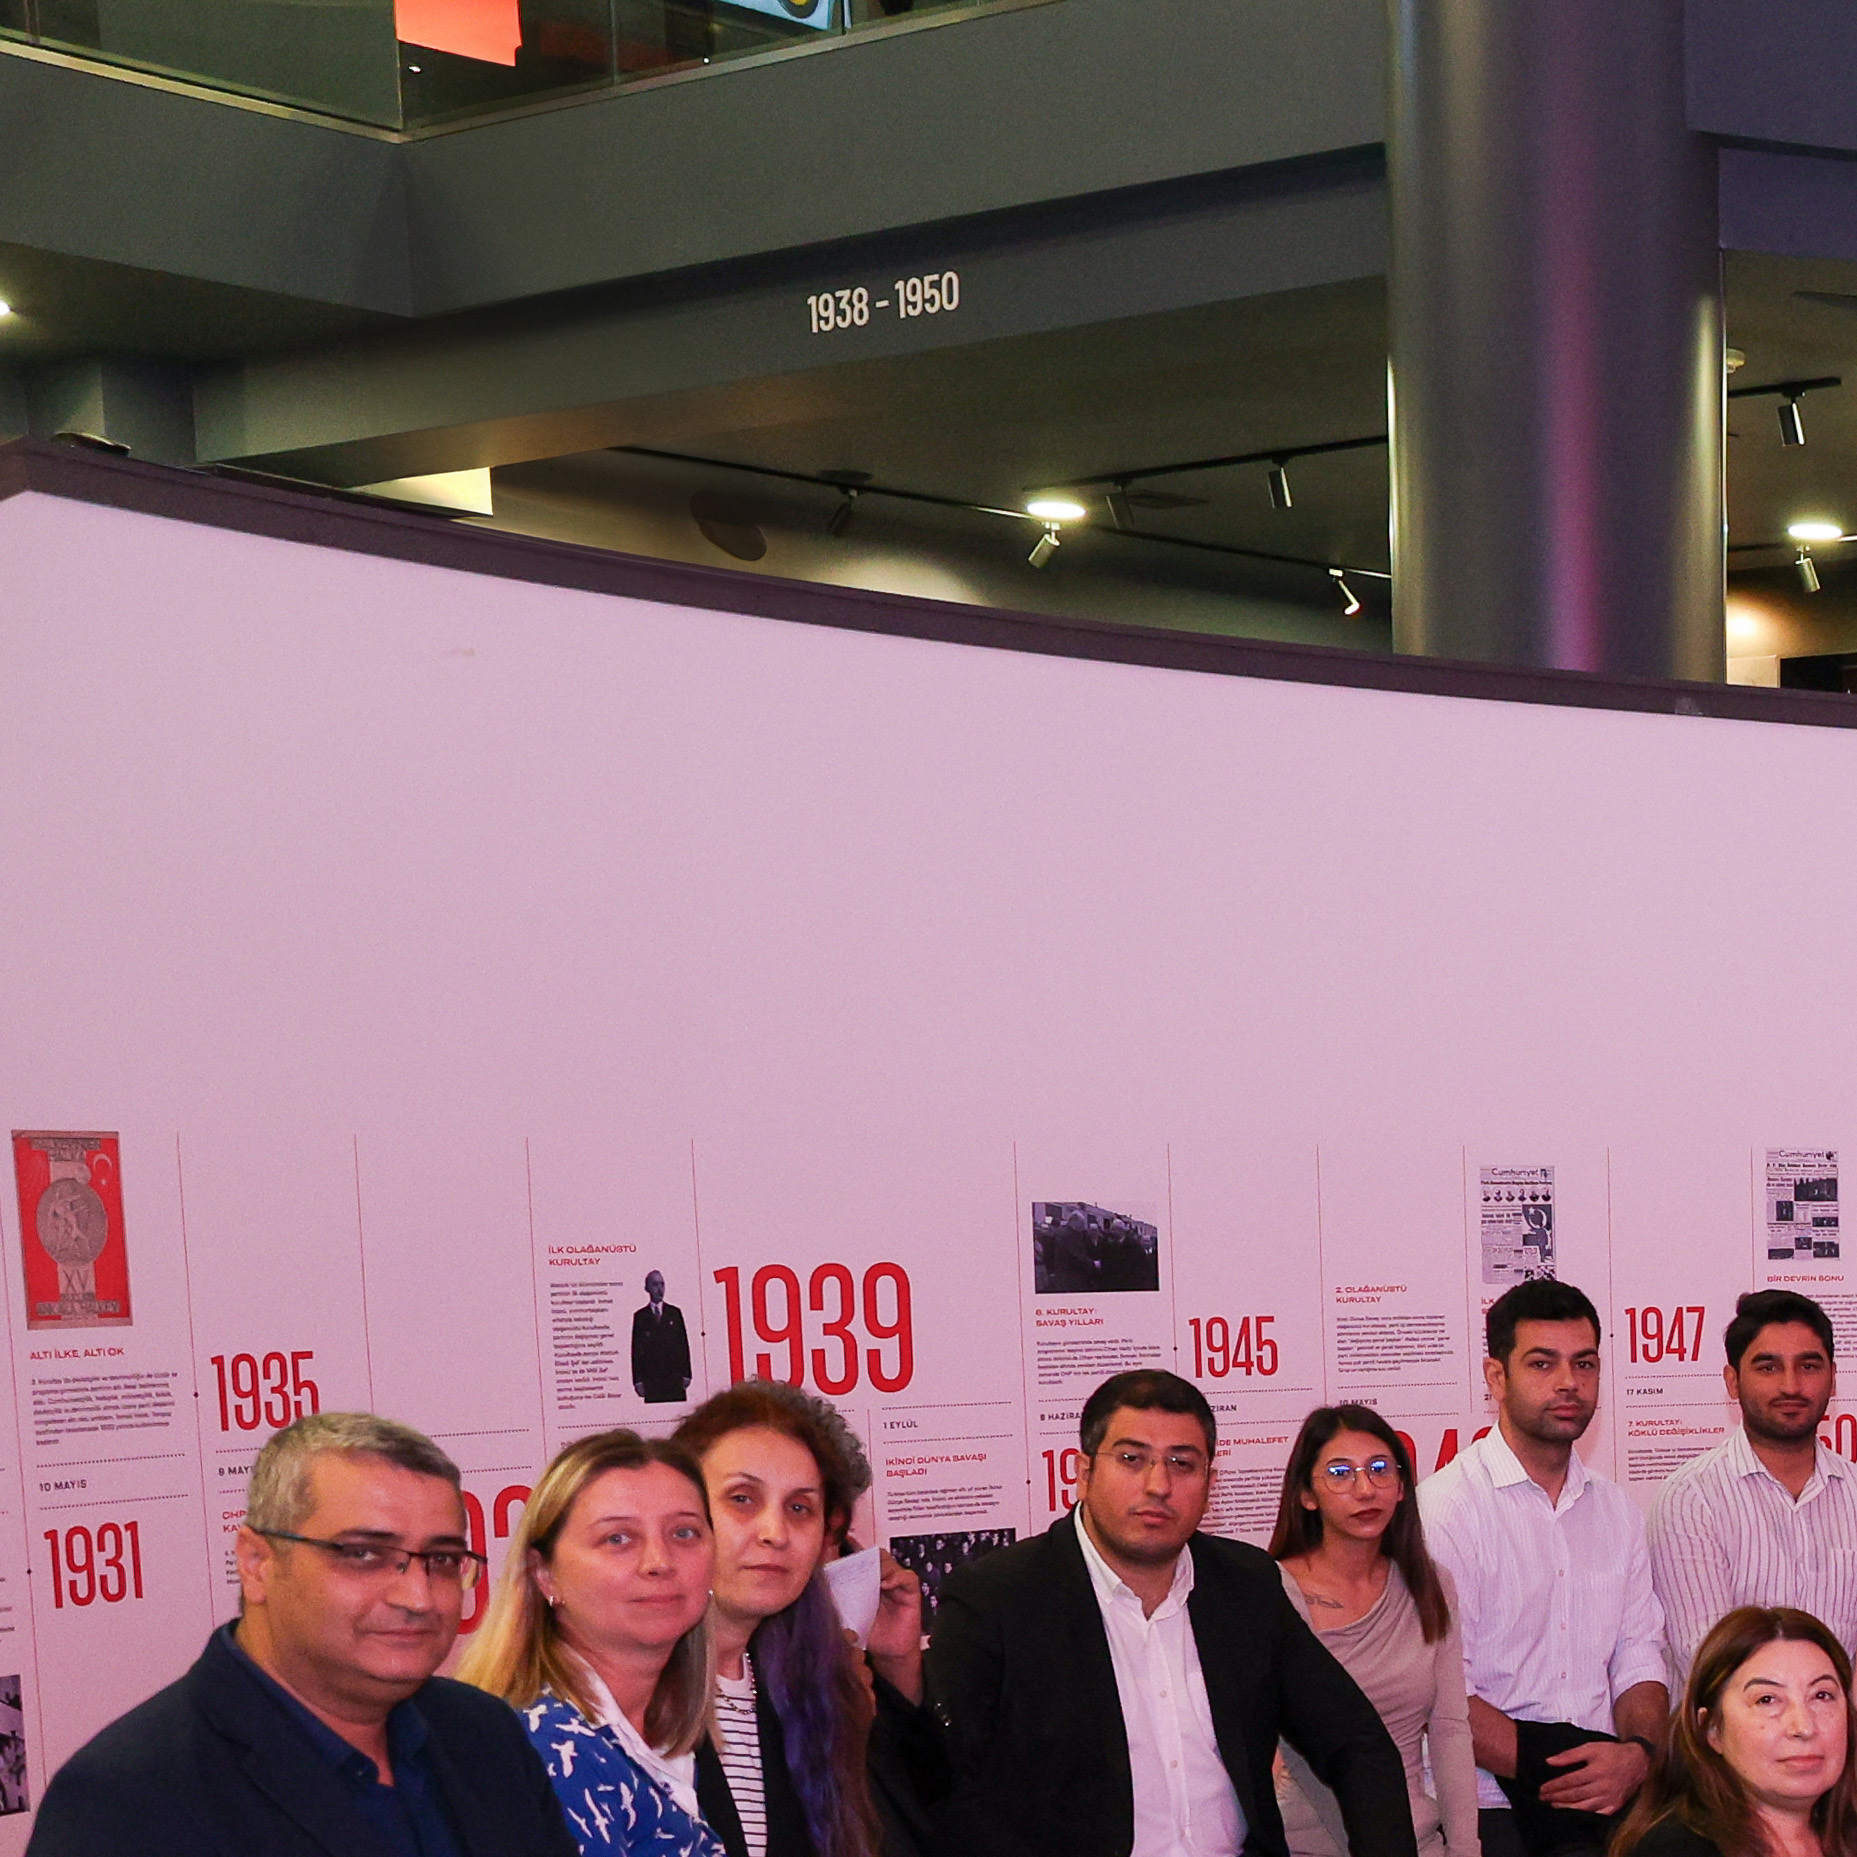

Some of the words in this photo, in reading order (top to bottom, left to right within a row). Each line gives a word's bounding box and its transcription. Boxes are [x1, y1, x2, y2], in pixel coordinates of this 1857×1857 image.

[807, 287, 870, 333] 1938
[894, 271, 960, 319] 1950
[549, 1246, 565, 1254] İLK
[549, 1257, 601, 1266] KURULTAY
[1336, 1296, 1382, 1304] KURULTAY
[712, 1261, 915, 1395] 1939
[1624, 1305, 1705, 1364] 1947
[1188, 1315, 1279, 1379] 1945
[210, 1351, 320, 1432] 1935
[1636, 1387, 1664, 1396] KASIM
[1233, 1436, 1290, 1446] MUHALEFET
[40, 1482, 52, 1492] 10
[54, 1479, 88, 1491] MAYIS
[43, 1521, 145, 1610] 1931
